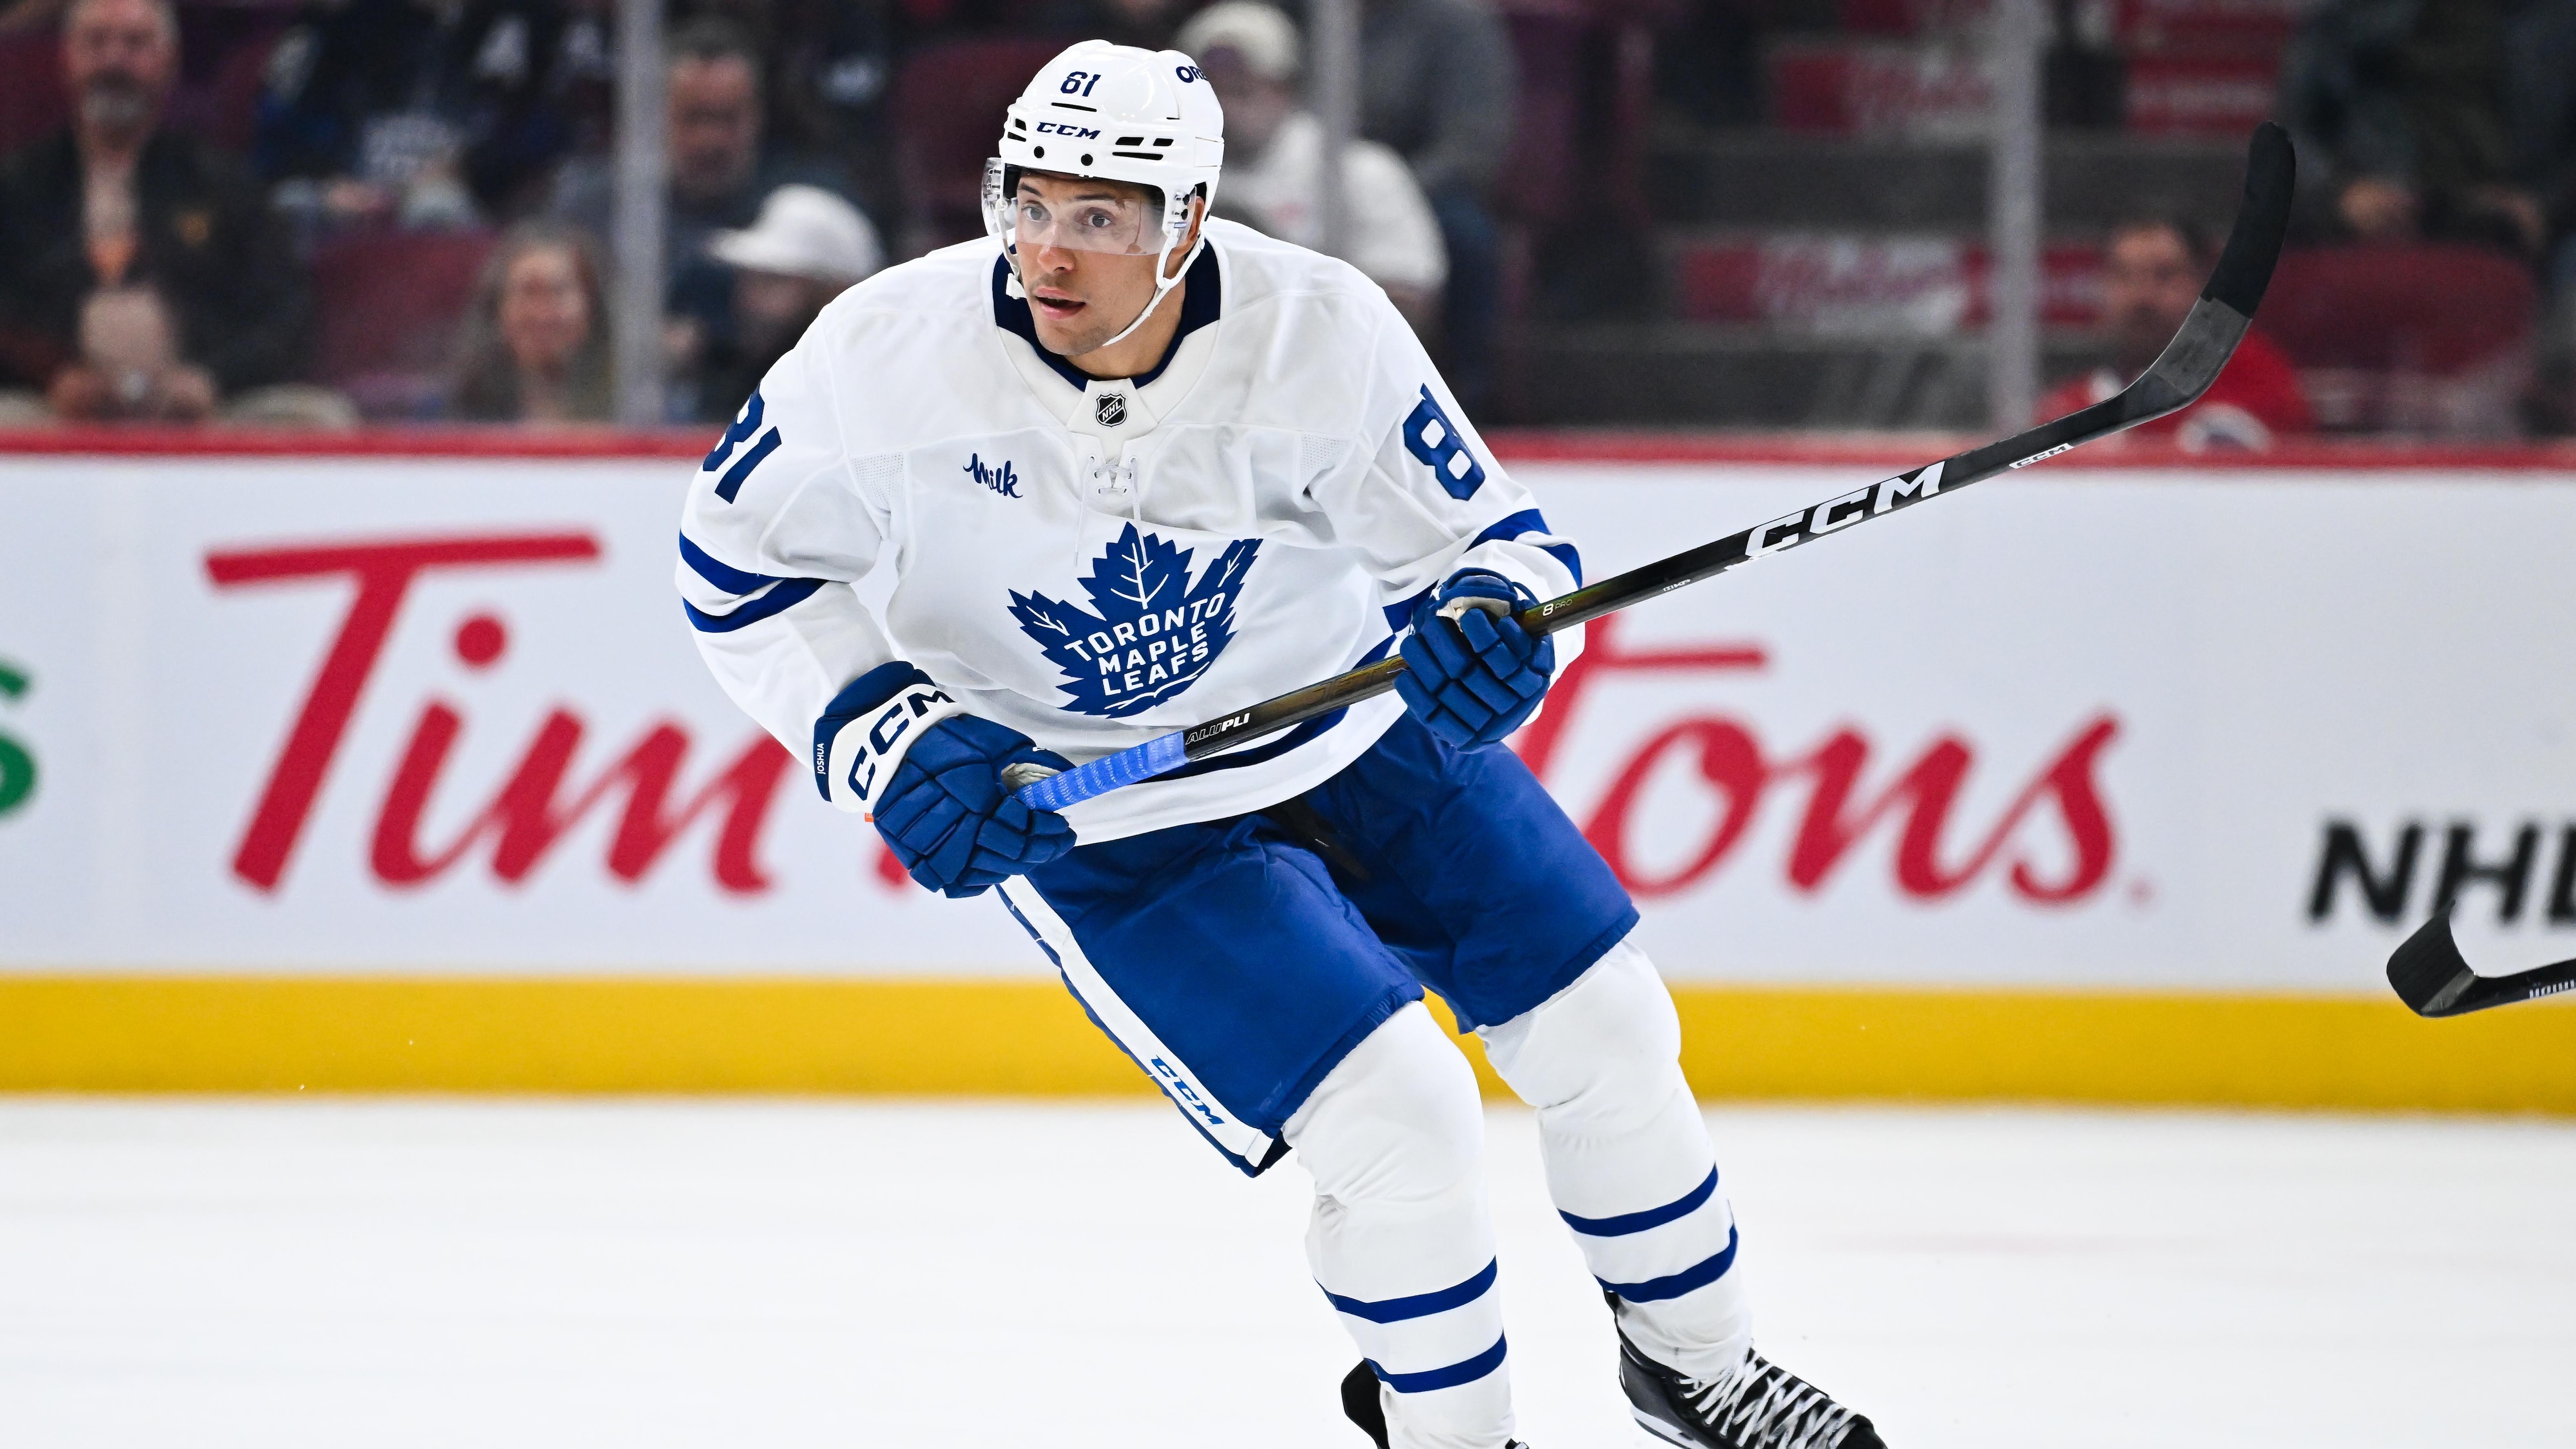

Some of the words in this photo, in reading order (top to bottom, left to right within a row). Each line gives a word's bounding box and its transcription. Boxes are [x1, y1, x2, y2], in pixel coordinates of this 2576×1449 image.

[1060, 71, 1101, 97] 61
[1176, 66, 1211, 84] ORE
[1037, 122, 1101, 140] CCM
[1102, 401, 1121, 421] NHL
[703, 381, 782, 504] 81
[1402, 382, 1486, 502] 8
[2016, 446, 2066, 467] CCM
[963, 453, 1023, 498] Milk
[1745, 461, 1945, 558] CCM
[1064, 592, 1226, 661] TORONTO
[1543, 603, 1554, 616] 8
[1555, 599, 1573, 609] PRO
[1098, 621, 1207, 675] MAPLE
[1103, 641, 1209, 696] LEAFS
[202, 531, 791, 896] Tim
[1185, 712, 1250, 745] ALUPLI
[817, 742, 825, 775] JOSHUA
[848, 690, 956, 801] CCM
[1150, 1054, 1225, 1125] CCM
